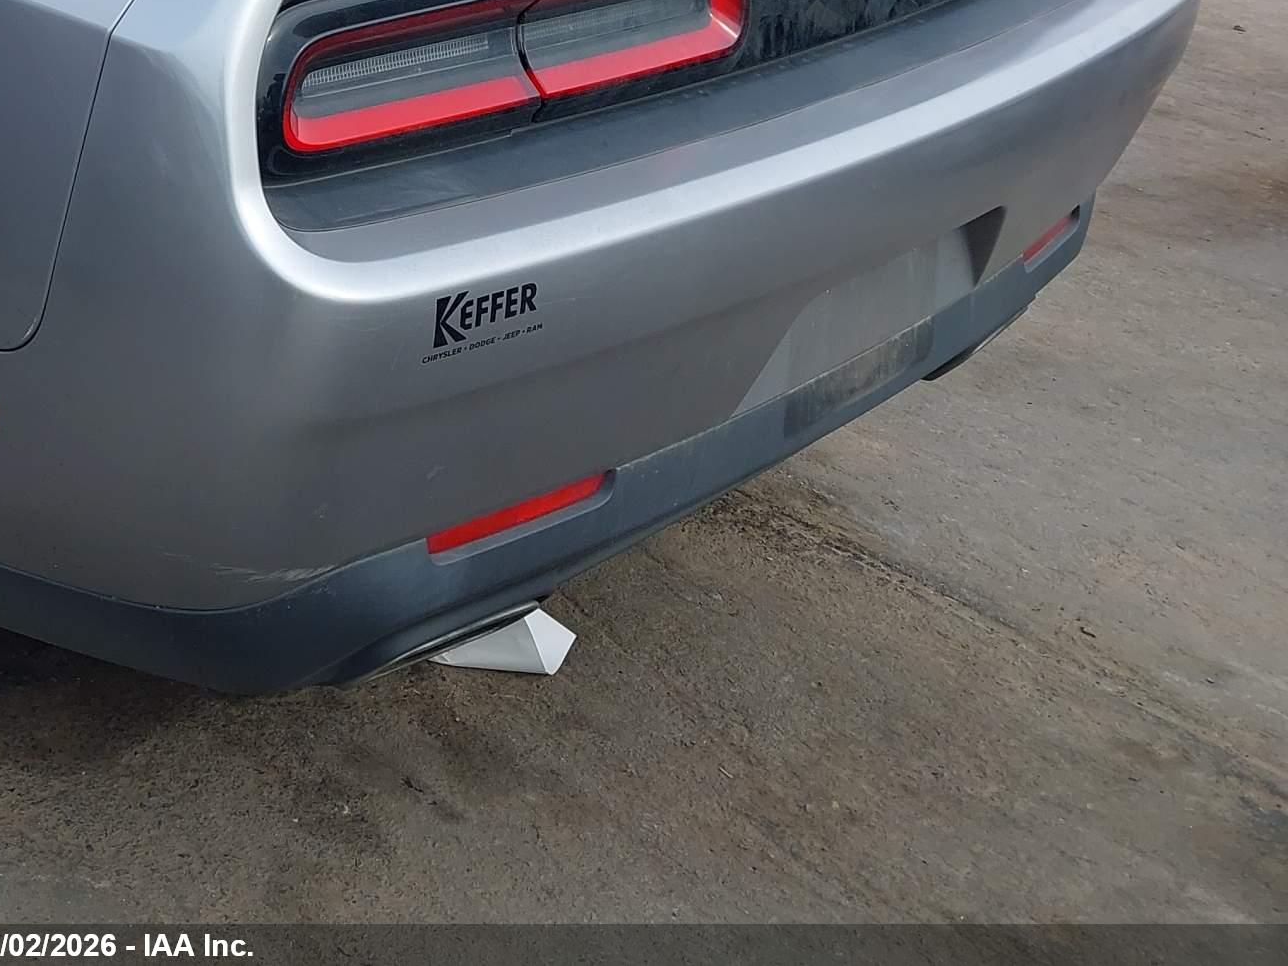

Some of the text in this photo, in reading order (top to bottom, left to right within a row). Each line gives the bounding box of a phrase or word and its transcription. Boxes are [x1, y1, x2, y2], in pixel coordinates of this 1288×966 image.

[433, 283, 537, 349] KEFFER
[421, 323, 543, 364] CHRYSLER DODGE JEEP RAM
